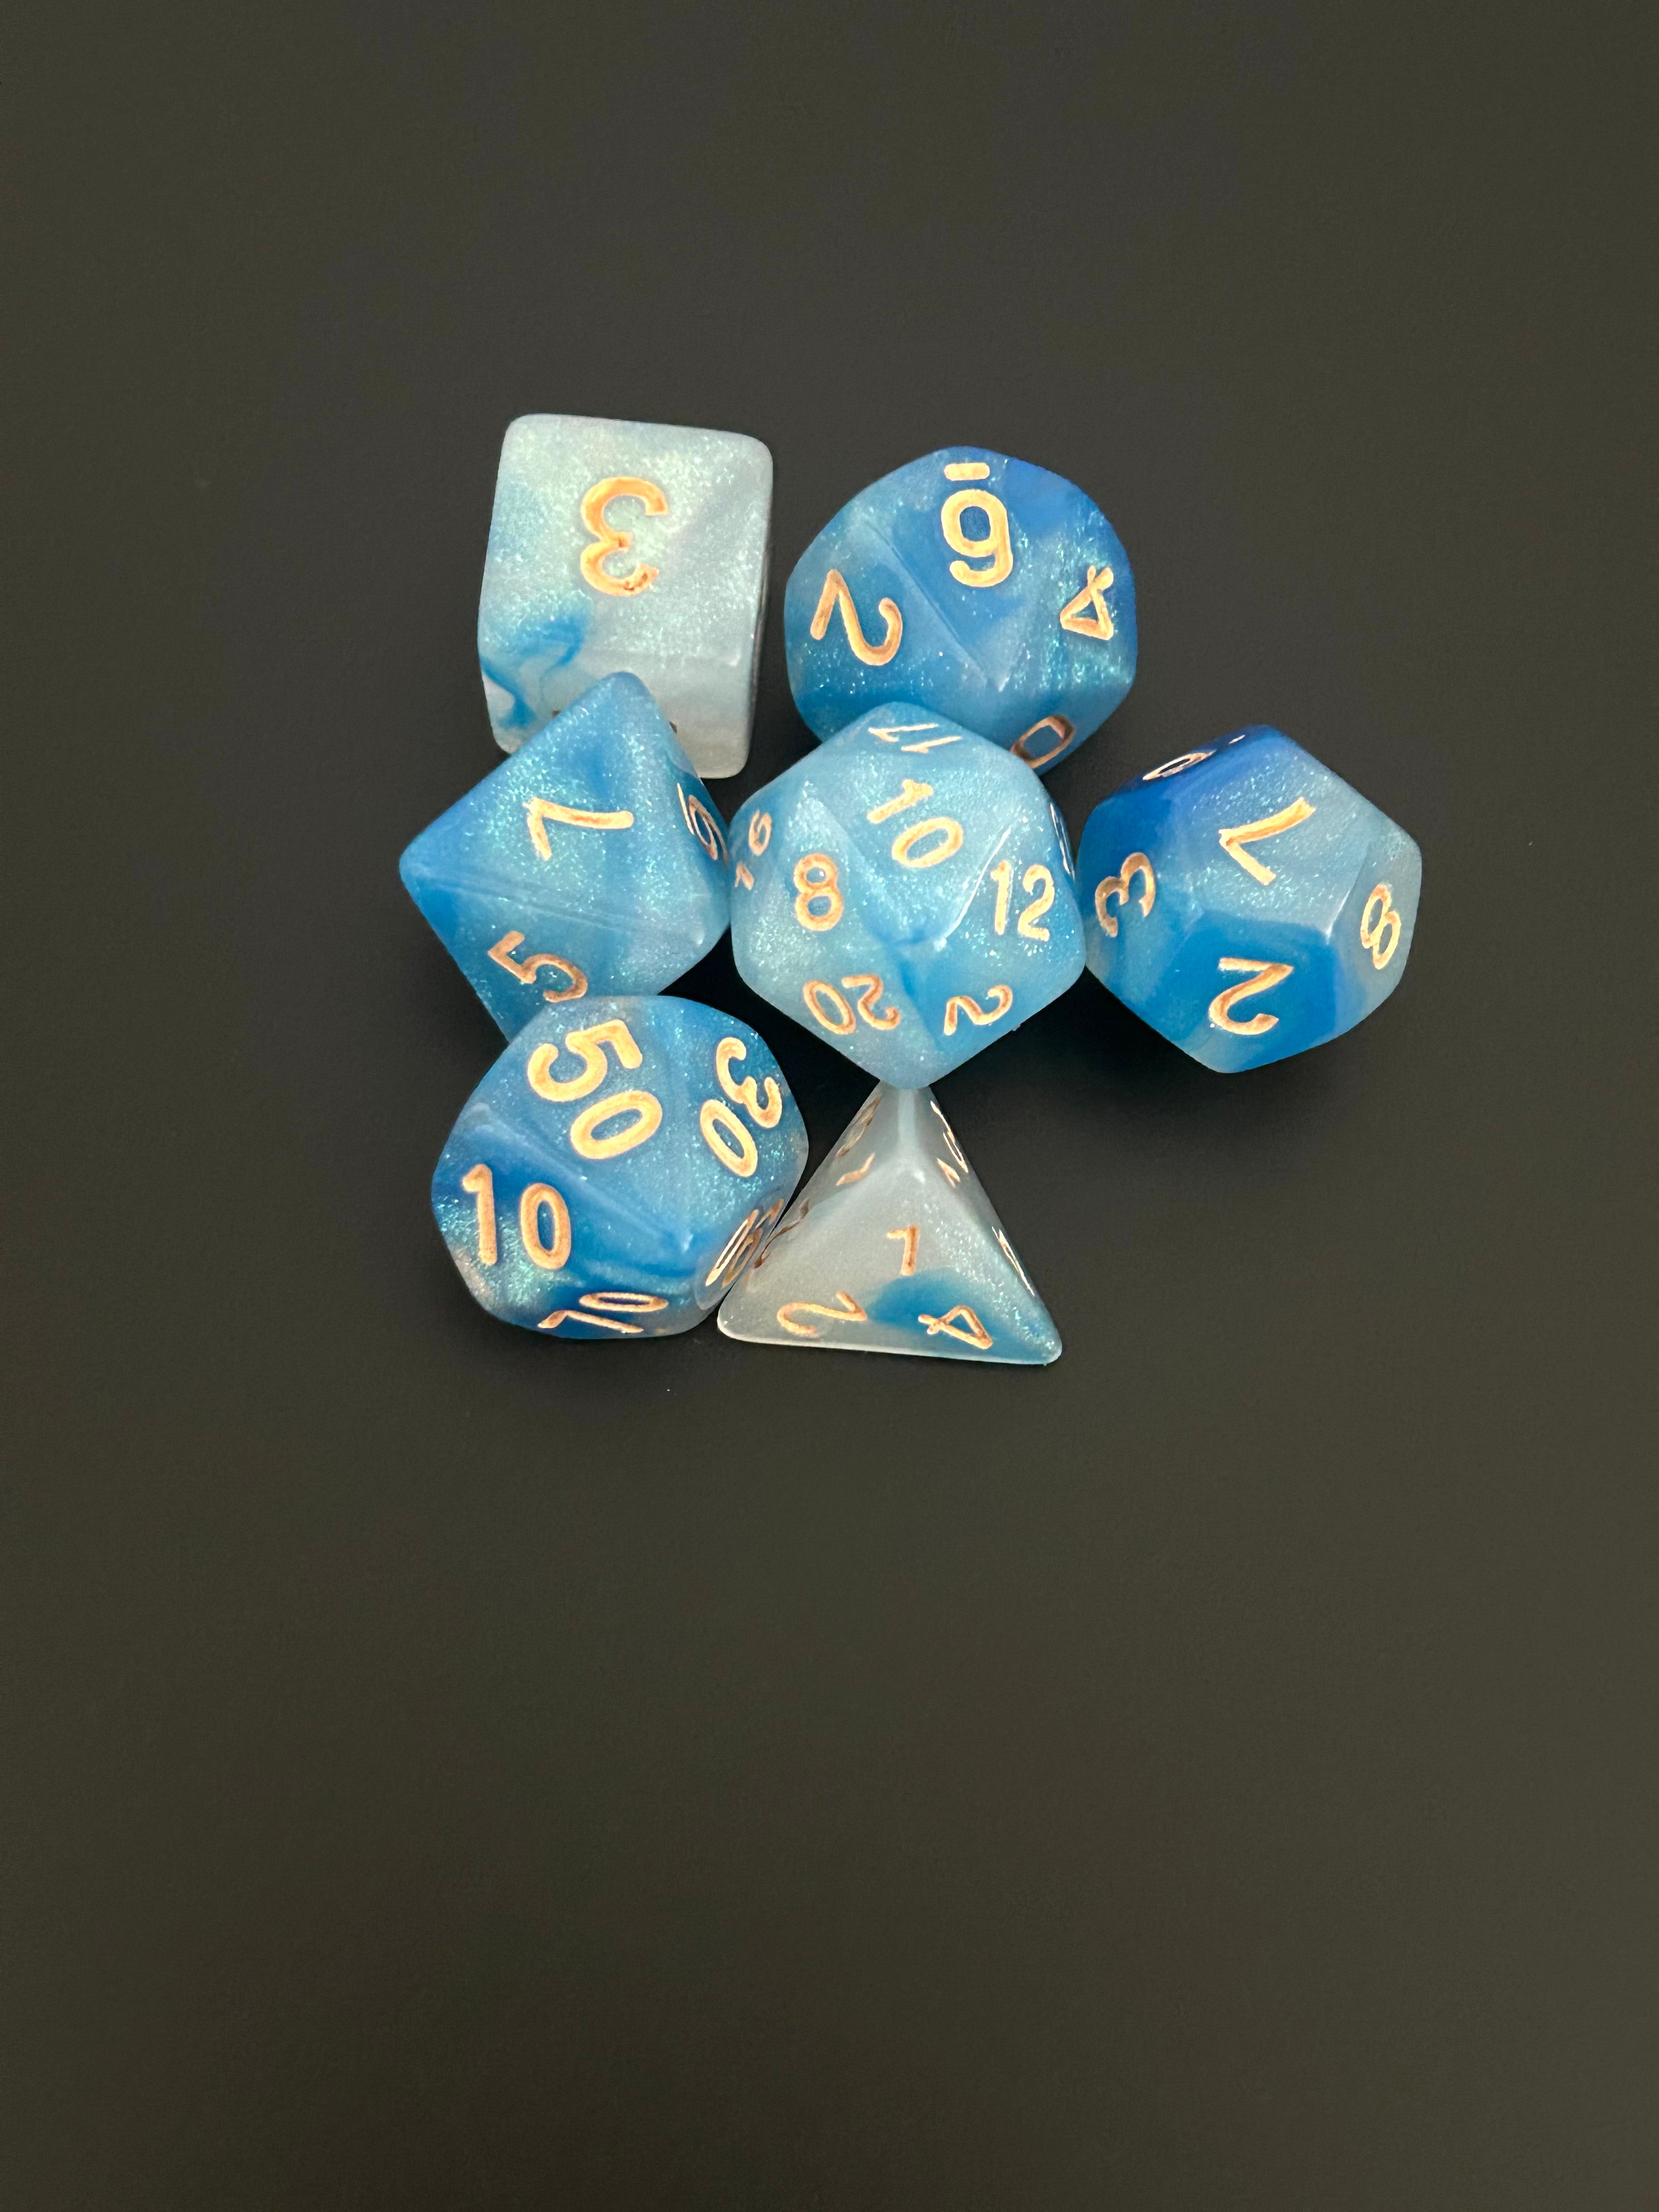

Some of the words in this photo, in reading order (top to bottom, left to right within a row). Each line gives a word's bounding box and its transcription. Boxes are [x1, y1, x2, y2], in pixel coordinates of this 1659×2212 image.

[580, 475, 669, 597] 3
[810, 568, 902, 665] 2
[1060, 565, 1114, 640] 4
[523, 797, 634, 860] 7
[867, 778, 964, 868] 10
[1219, 797, 1316, 885] 7
[793, 853, 844, 932] 8
[991, 860, 1055, 941] 12
[1095, 852, 1156, 938] 3
[1360, 883, 1402, 970] 8
[488, 930, 588, 1003] 5
[803, 973, 901, 1035] 20
[1209, 957, 1294, 1036] 2
[944, 984, 1013, 1035] 2
[527, 1019, 663, 1160] 50
[699, 1036, 783, 1178] 30
[462, 1163, 572, 1271] 10
[886, 1223, 921, 1276] 1
[776, 1291, 868, 1337] 2
[918, 1305, 994, 1350] 4
